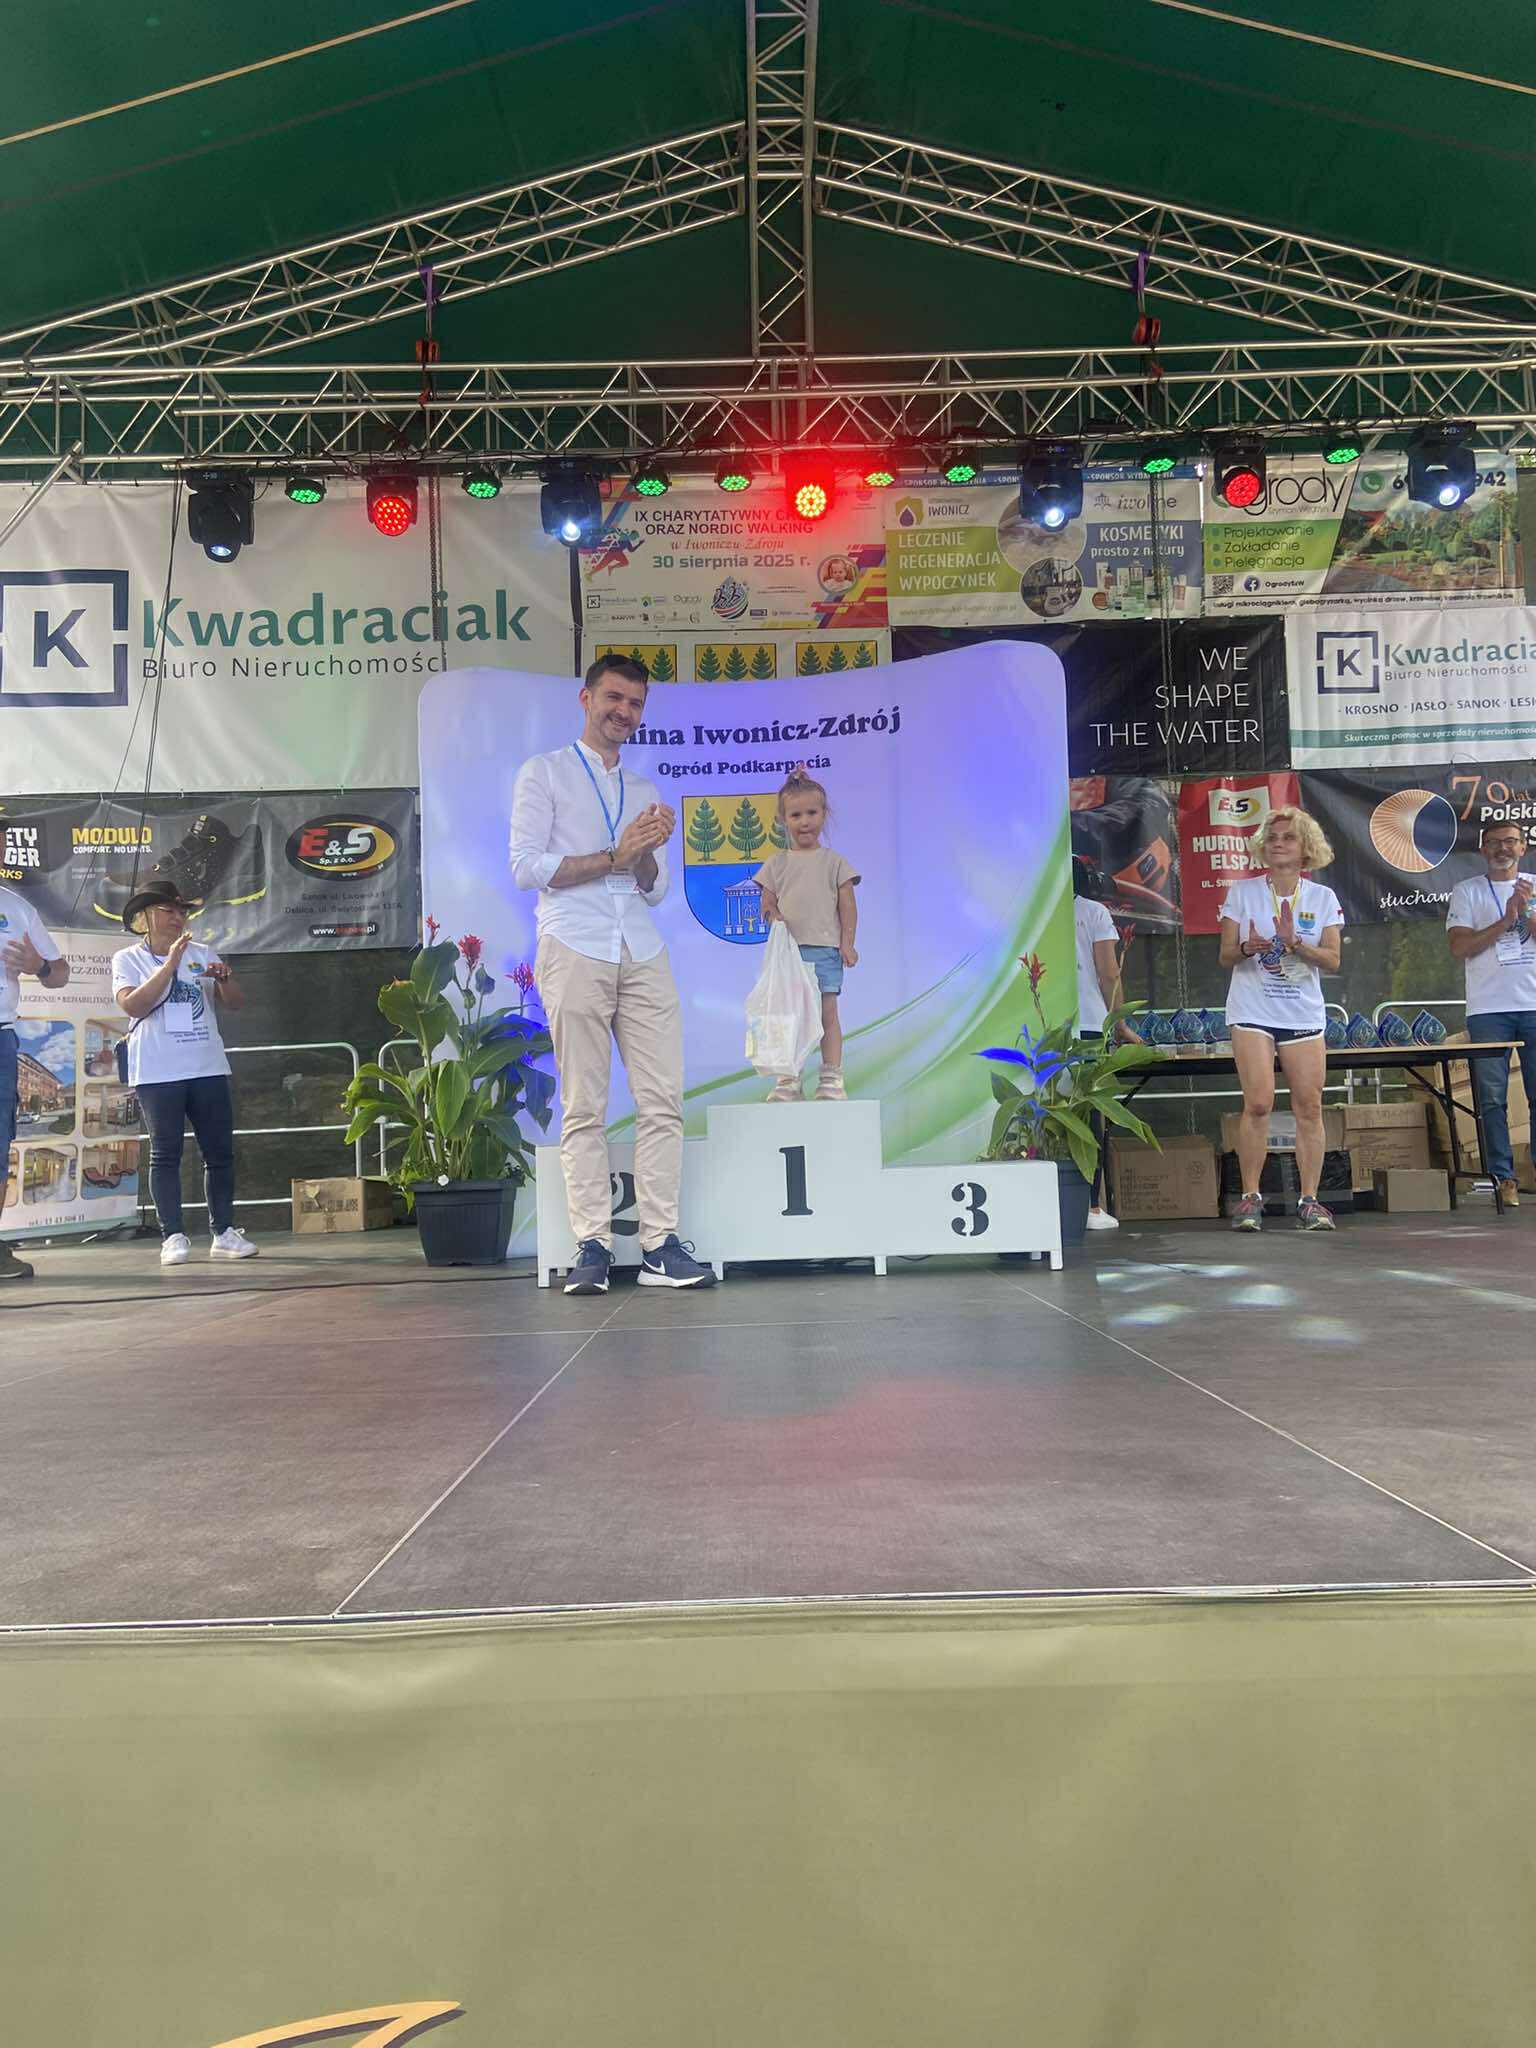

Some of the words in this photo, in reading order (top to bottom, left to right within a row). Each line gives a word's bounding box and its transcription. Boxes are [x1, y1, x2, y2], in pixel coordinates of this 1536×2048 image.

[1247, 469, 1347, 515] grody
[635, 510, 648, 522] IX
[652, 509, 772, 522] CHARYTATYWNY
[928, 504, 969, 516] IWONICZ
[645, 523, 685, 535] ORAZ
[689, 523, 744, 534] NORDIC
[748, 523, 813, 534] WALKING
[1223, 525, 1315, 538] Projektowanie
[899, 531, 965, 548] LECZENIE
[899, 551, 1001, 569] REGENERACJA
[1091, 544, 1129, 558] prosto
[1132, 547, 1140, 556] z
[653, 556, 674, 569] 30
[679, 555, 749, 570] sierpnia
[753, 554, 795, 568] 2025
[800, 555, 811, 567] r.
[899, 572, 997, 590] WYPOCZYNEK
[143, 589, 532, 648] Kwadraciak
[33, 609, 89, 668] K
[143, 657, 217, 679] Biuro
[231, 651, 445, 677] Nieruchomośc
[1200, 647, 1248, 671] WE
[1337, 649, 1362, 676] K
[1385, 670, 1422, 681] Biuro
[1427, 663, 1528, 678] Nieruchomości
[1155, 683, 1249, 708] SHAPE
[1345, 703, 1399, 715] KROSNO
[1410, 701, 1447, 713] JASŁO
[1457, 699, 1501, 709] SANOK
[693, 706, 901, 745] Iwonicz-Zdrój
[1090, 722, 1148, 746] THE
[1156, 719, 1260, 744] WATER
[1391, 731, 1421, 741] pomoc
[658, 761, 712, 777] Ogród
[717, 754, 832, 775] Podkarpacia
[72, 827, 152, 845] MODULO
[298, 827, 373, 857] E&S
[319, 857, 333, 865] Sp.
[779, 1145, 813, 1216] 1
[950, 1181, 989, 1237] 3
